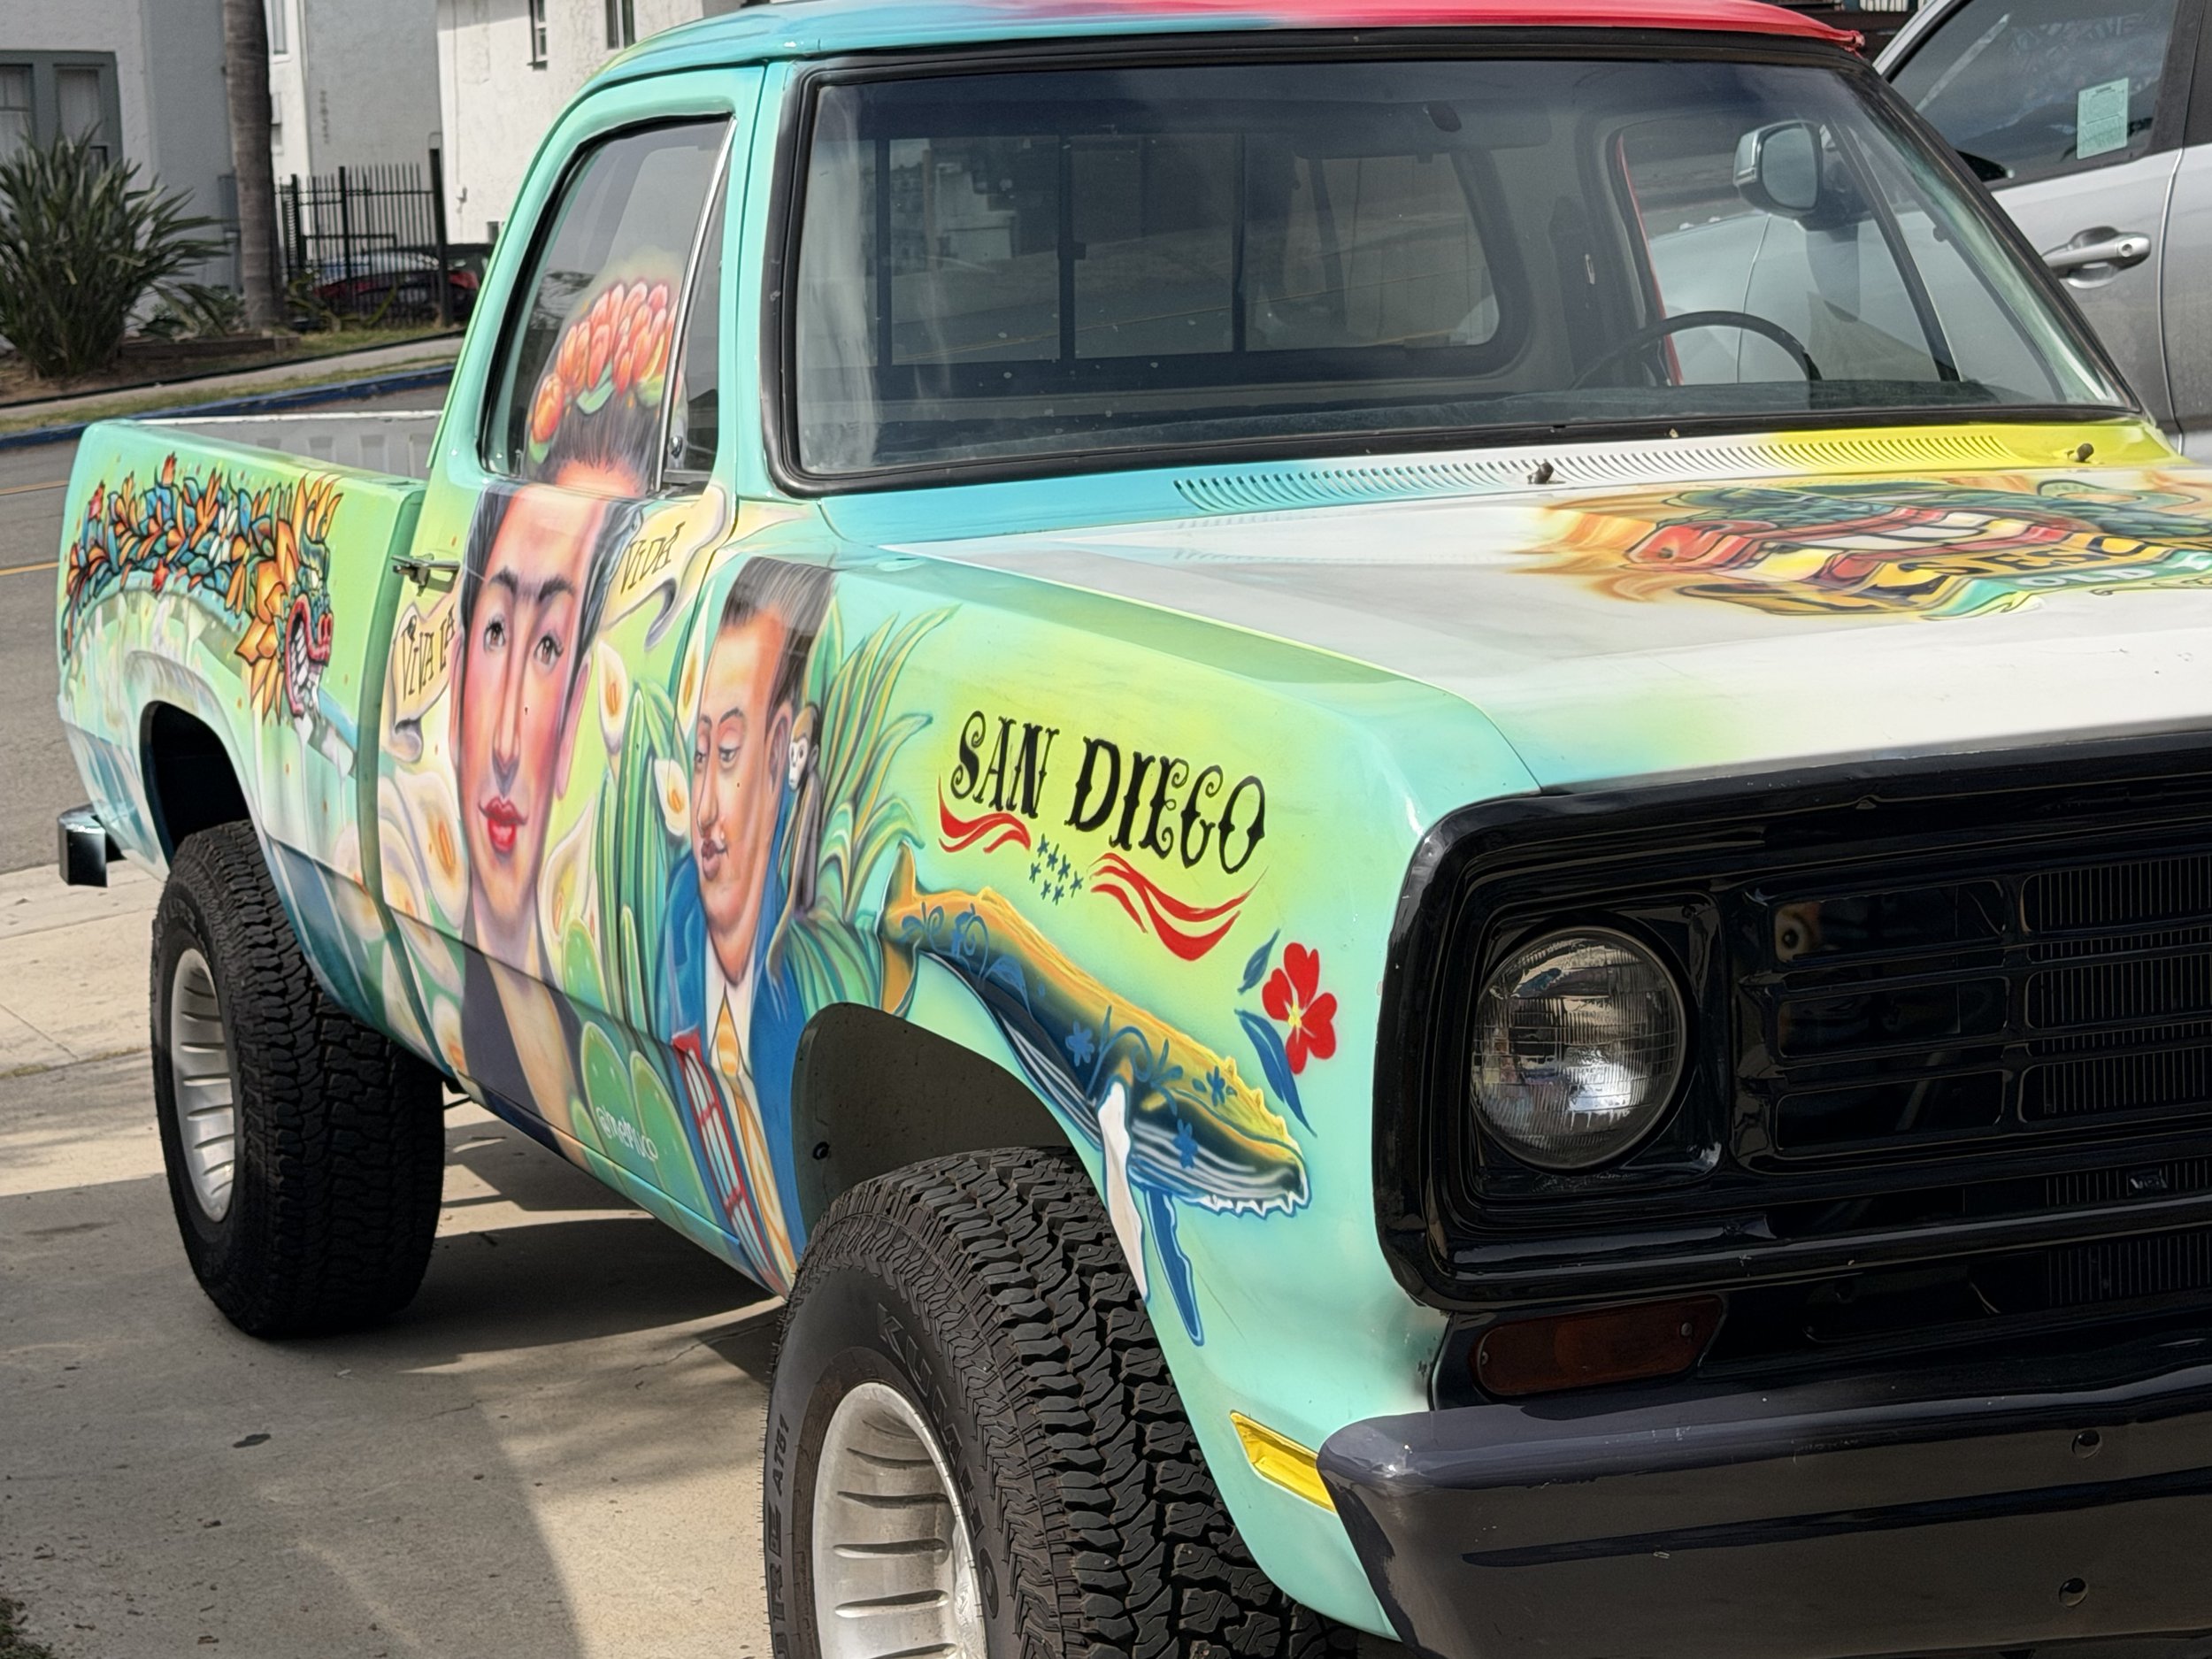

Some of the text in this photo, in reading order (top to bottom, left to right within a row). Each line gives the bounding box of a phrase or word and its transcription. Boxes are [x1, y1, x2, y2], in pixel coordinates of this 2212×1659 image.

[439, 603, 456, 673] LA
[620, 520, 686, 595] VIDA
[2017, 568, 2157, 587] OLD
[950, 710, 1266, 874] SAN DIEGO
[878, 1302, 998, 1620] KUMHO
